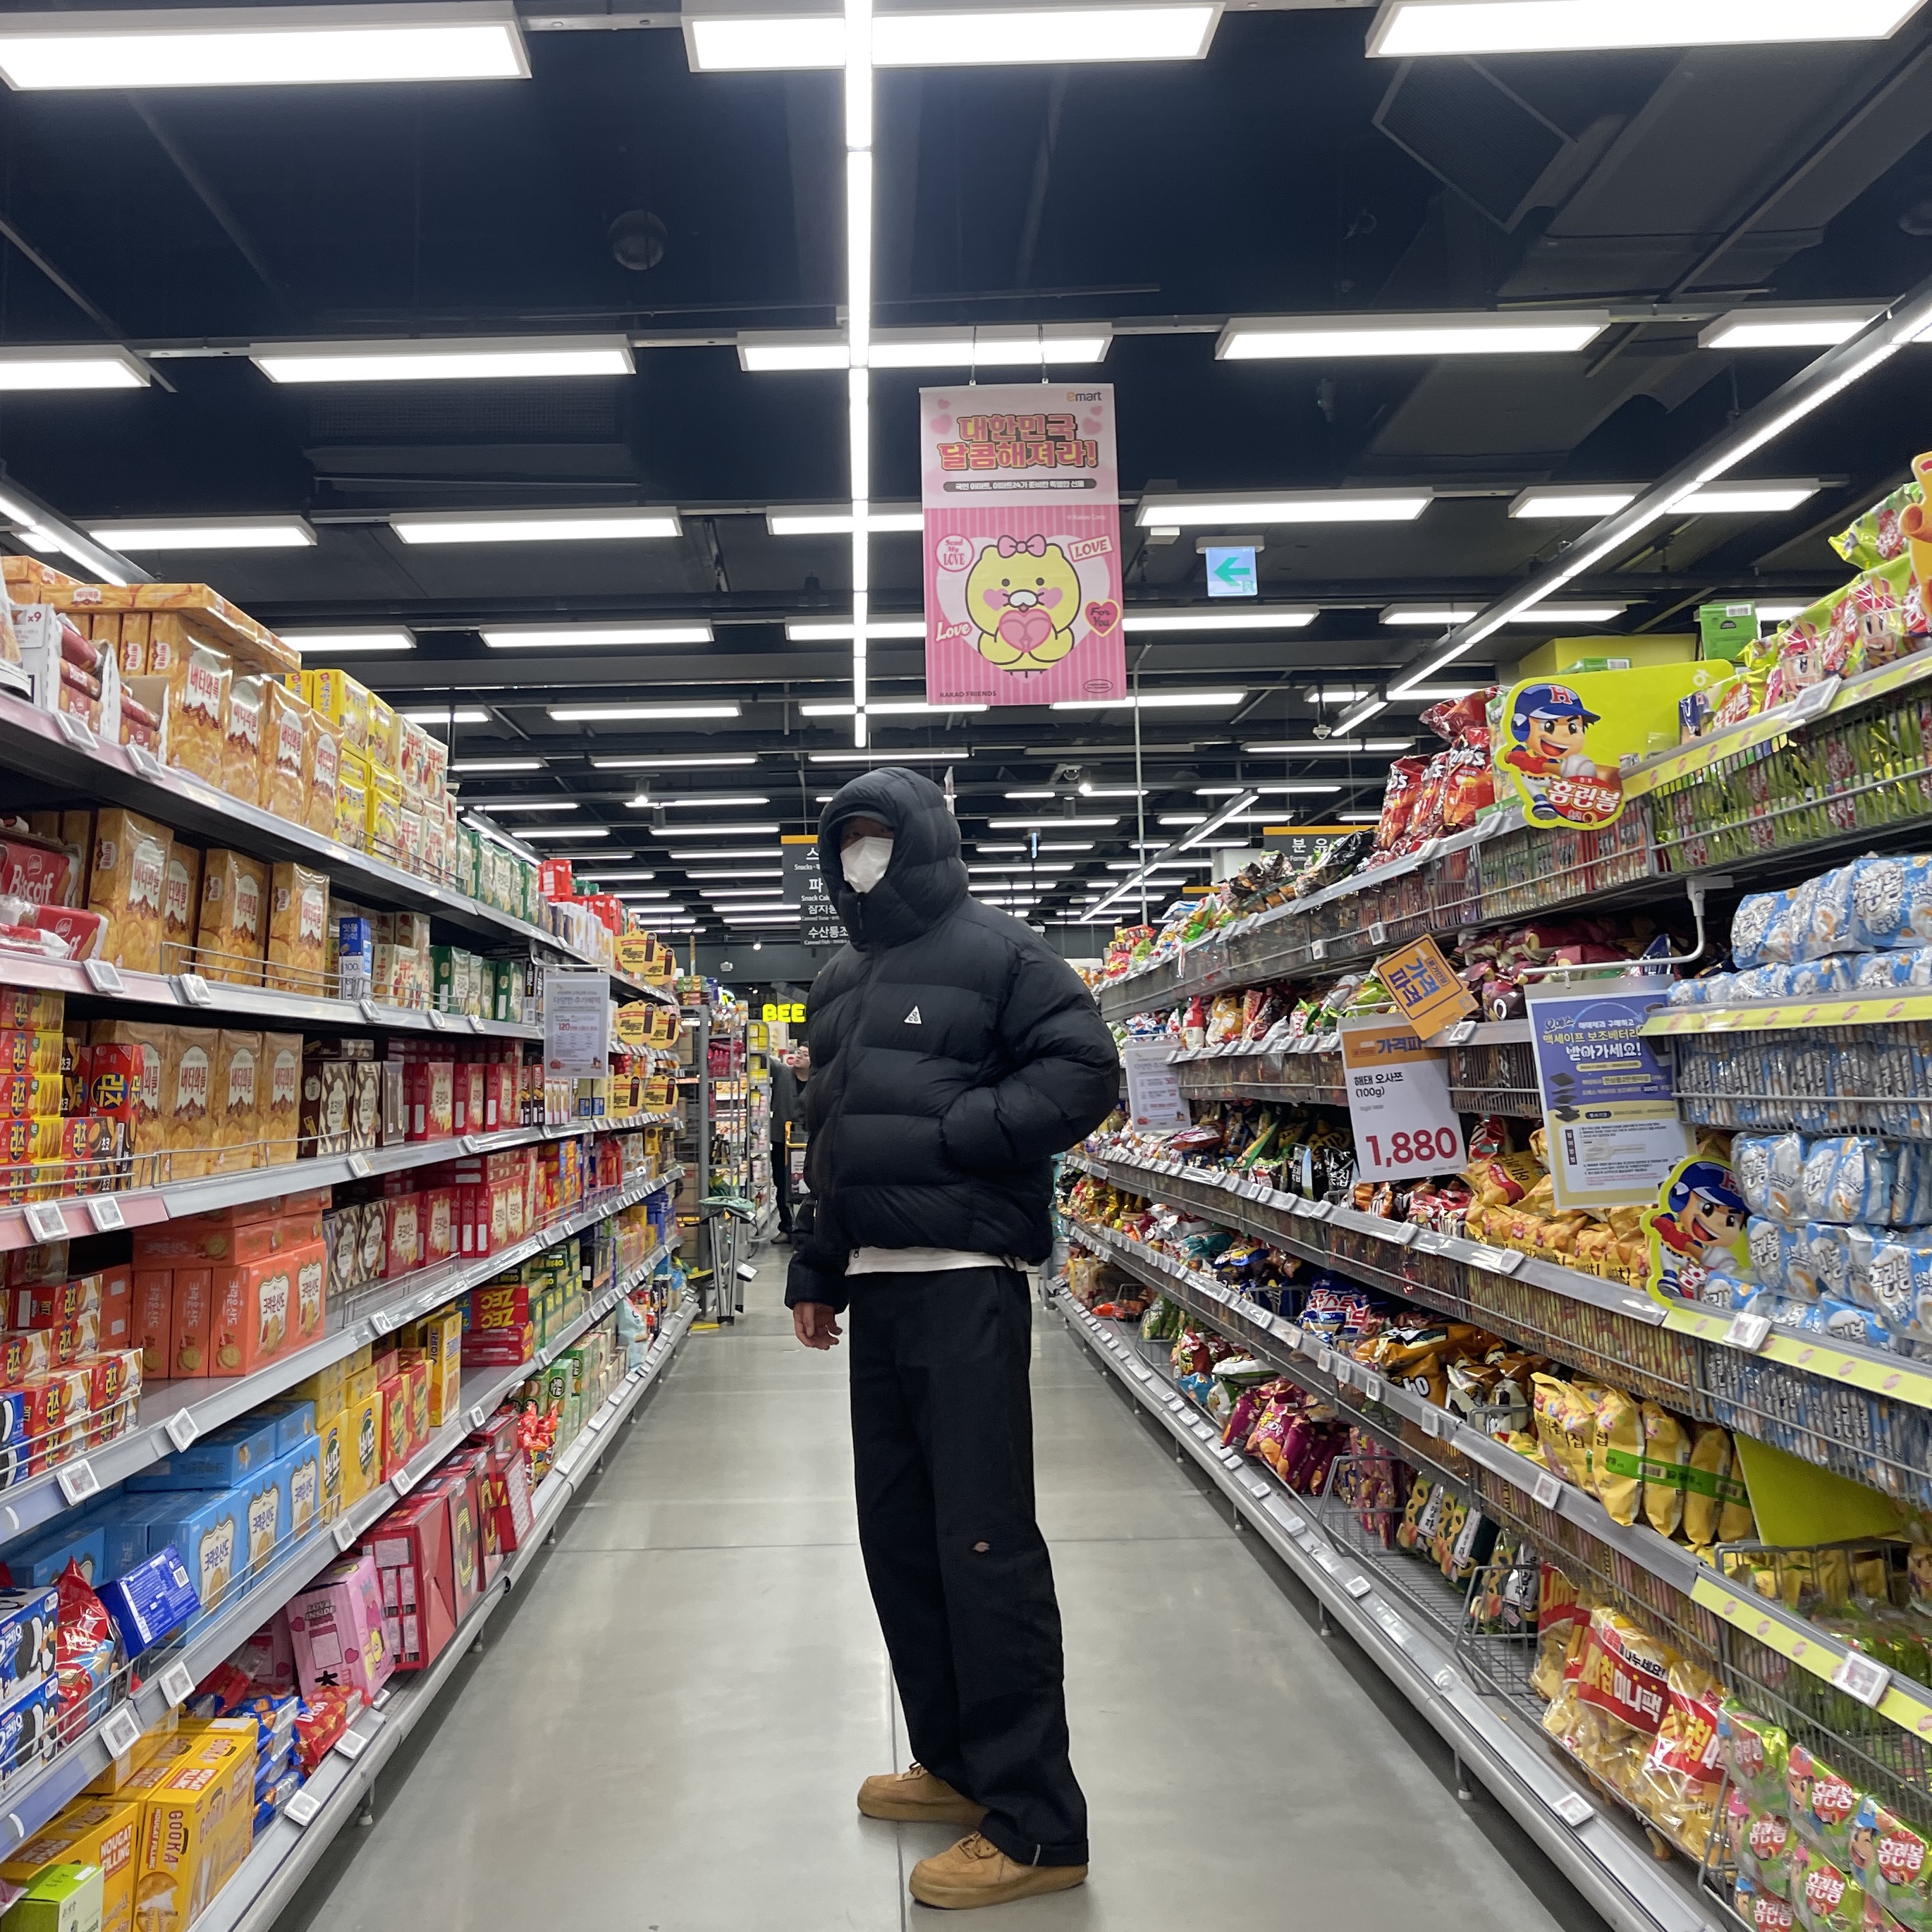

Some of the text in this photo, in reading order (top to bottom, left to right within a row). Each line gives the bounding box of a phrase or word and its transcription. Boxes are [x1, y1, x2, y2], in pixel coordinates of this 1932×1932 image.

[1067, 391, 1102, 402] emart
[957, 414, 1077, 441] 대한민국
[938, 441, 1098, 470] 달콤해져라!
[943, 553, 965, 565] LOVE
[1075, 539, 1108, 558] LOVE
[1090, 606, 1111, 617] For
[1093, 616, 1109, 628] You
[936, 621, 971, 642] Love
[1548, 781, 1621, 813] 홈런볼
[1292, 838, 1307, 853] 분
[8, 864, 54, 905] Biscoff
[169, 879, 187, 910] 터와플
[808, 926, 849, 939] 수산통조
[1388, 967, 1424, 1008] 파격
[1404, 958, 1441, 998] 가격
[762, 1003, 805, 1023] BEE
[1376, 1037, 1424, 1055] 가격파
[1543, 1032, 1585, 1044] 맥세이프
[1566, 1042, 1642, 1061] 받아가세요!
[98, 1074, 125, 1108] 리츠
[1354, 1072, 1403, 1087] 해태 오사쯔
[1355, 1087, 1385, 1098] (100g)
[1366, 1127, 1457, 1169] 1,880
[227, 1280, 239, 1326] 크라운산도
[481, 1288, 515, 1309] ZEC
[482, 1307, 515, 1329] ZEC
[1614, 1668, 1663, 1723] 미니팩
[1811, 1782, 1853, 1809] 홈런볼
[152, 1808, 161, 1840] NOUGAT
[164, 1810, 183, 1863] GOOKA
[1749, 1822, 1787, 1845] 홈런볼
[101, 1823, 133, 1857] NOUGAT
[102, 1842, 130, 1872] FILLING
[1877, 1838, 1925, 1870] 홈런볼
[1805, 1872, 1845, 1905] 홈런볼
[1754, 1899, 1793, 1927] 홈런볼
